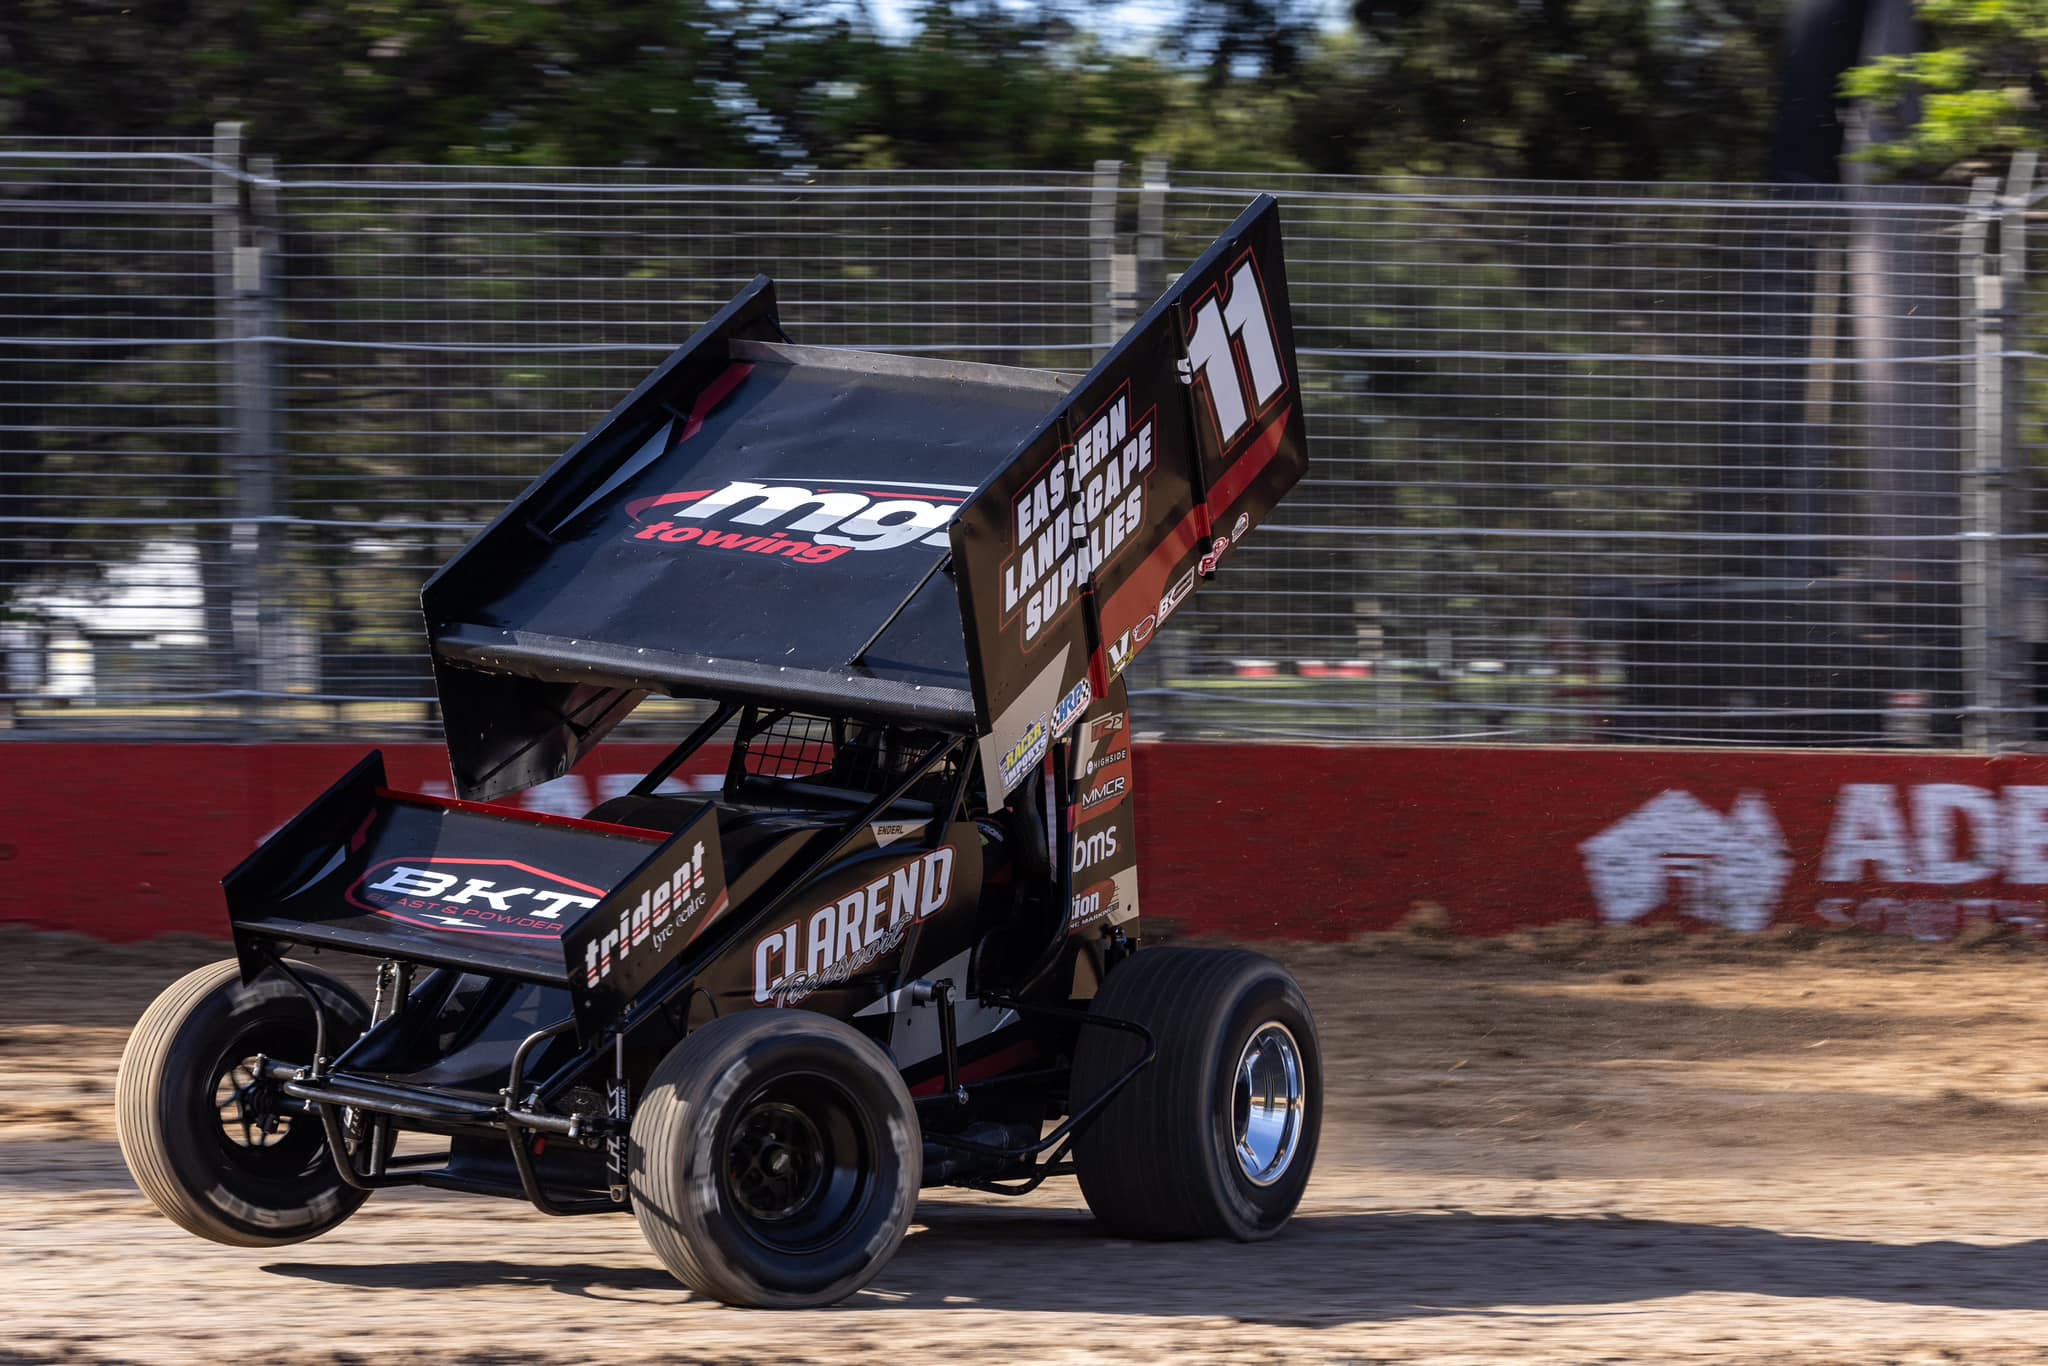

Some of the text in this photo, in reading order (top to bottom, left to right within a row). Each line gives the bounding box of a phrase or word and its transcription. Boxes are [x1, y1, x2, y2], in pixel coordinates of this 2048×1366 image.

[1017, 395, 1127, 546] EASTERN
[635, 521, 852, 564] towing
[1005, 421, 1152, 613] LANDSCAPE
[1026, 485, 1142, 640] SUPPLIES
[1004, 734, 1048, 786] IMPORTS
[1006, 722, 1042, 770] RACER
[1093, 750, 1126, 768] HIGHSIDE
[1083, 777, 1125, 806] MMCR
[366, 892, 565, 932] BLAST & POWDER
[368, 866, 602, 919] BKT
[585, 841, 705, 988] trident
[755, 848, 953, 1003] CLAREND
[768, 912, 913, 1008] Transport
